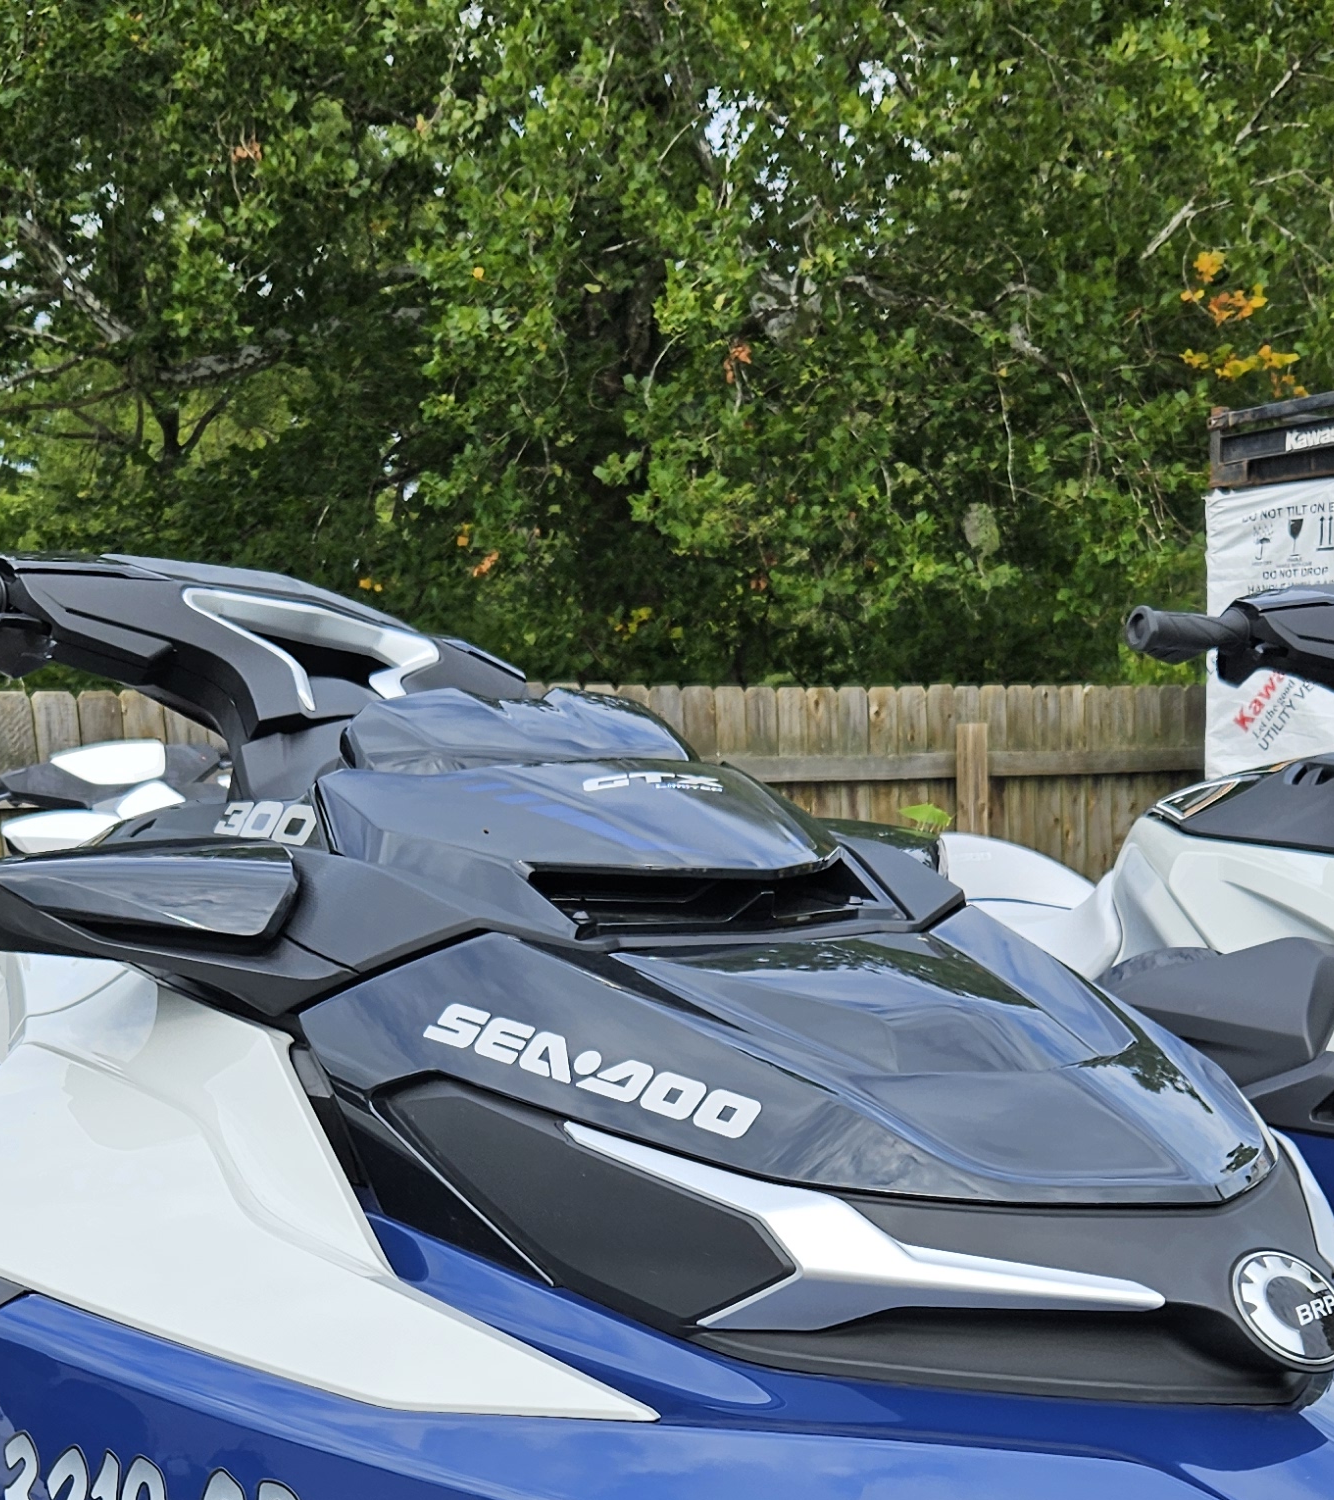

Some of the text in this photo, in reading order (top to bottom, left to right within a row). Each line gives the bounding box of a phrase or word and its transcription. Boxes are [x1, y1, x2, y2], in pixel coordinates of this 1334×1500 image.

[1260, 507, 1283, 520] NOT
[1286, 504, 1308, 517] TILT
[1279, 568, 1299, 578] NOT
[1301, 566, 1329, 577] DROP
[1258, 698, 1297, 751] UTILITY
[582, 771, 724, 792] GTX
[213, 801, 317, 846] 300
